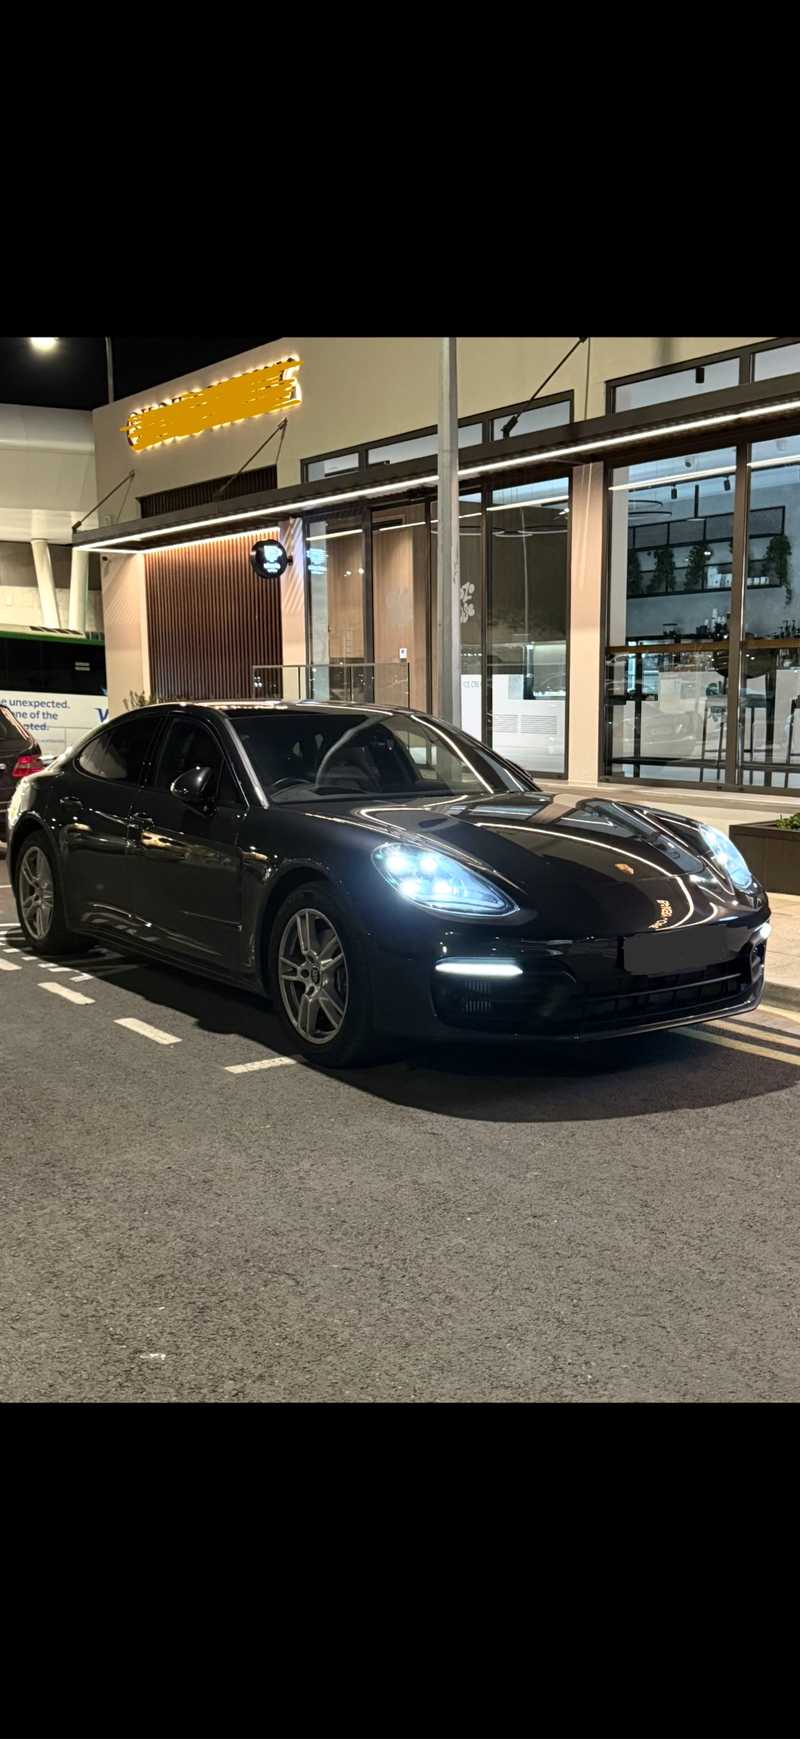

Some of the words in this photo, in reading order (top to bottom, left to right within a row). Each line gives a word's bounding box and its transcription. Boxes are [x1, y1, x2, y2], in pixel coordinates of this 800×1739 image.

[9, 699, 71, 709] unexpected.
[29, 710, 40, 719] of
[42, 711, 58, 720] the
